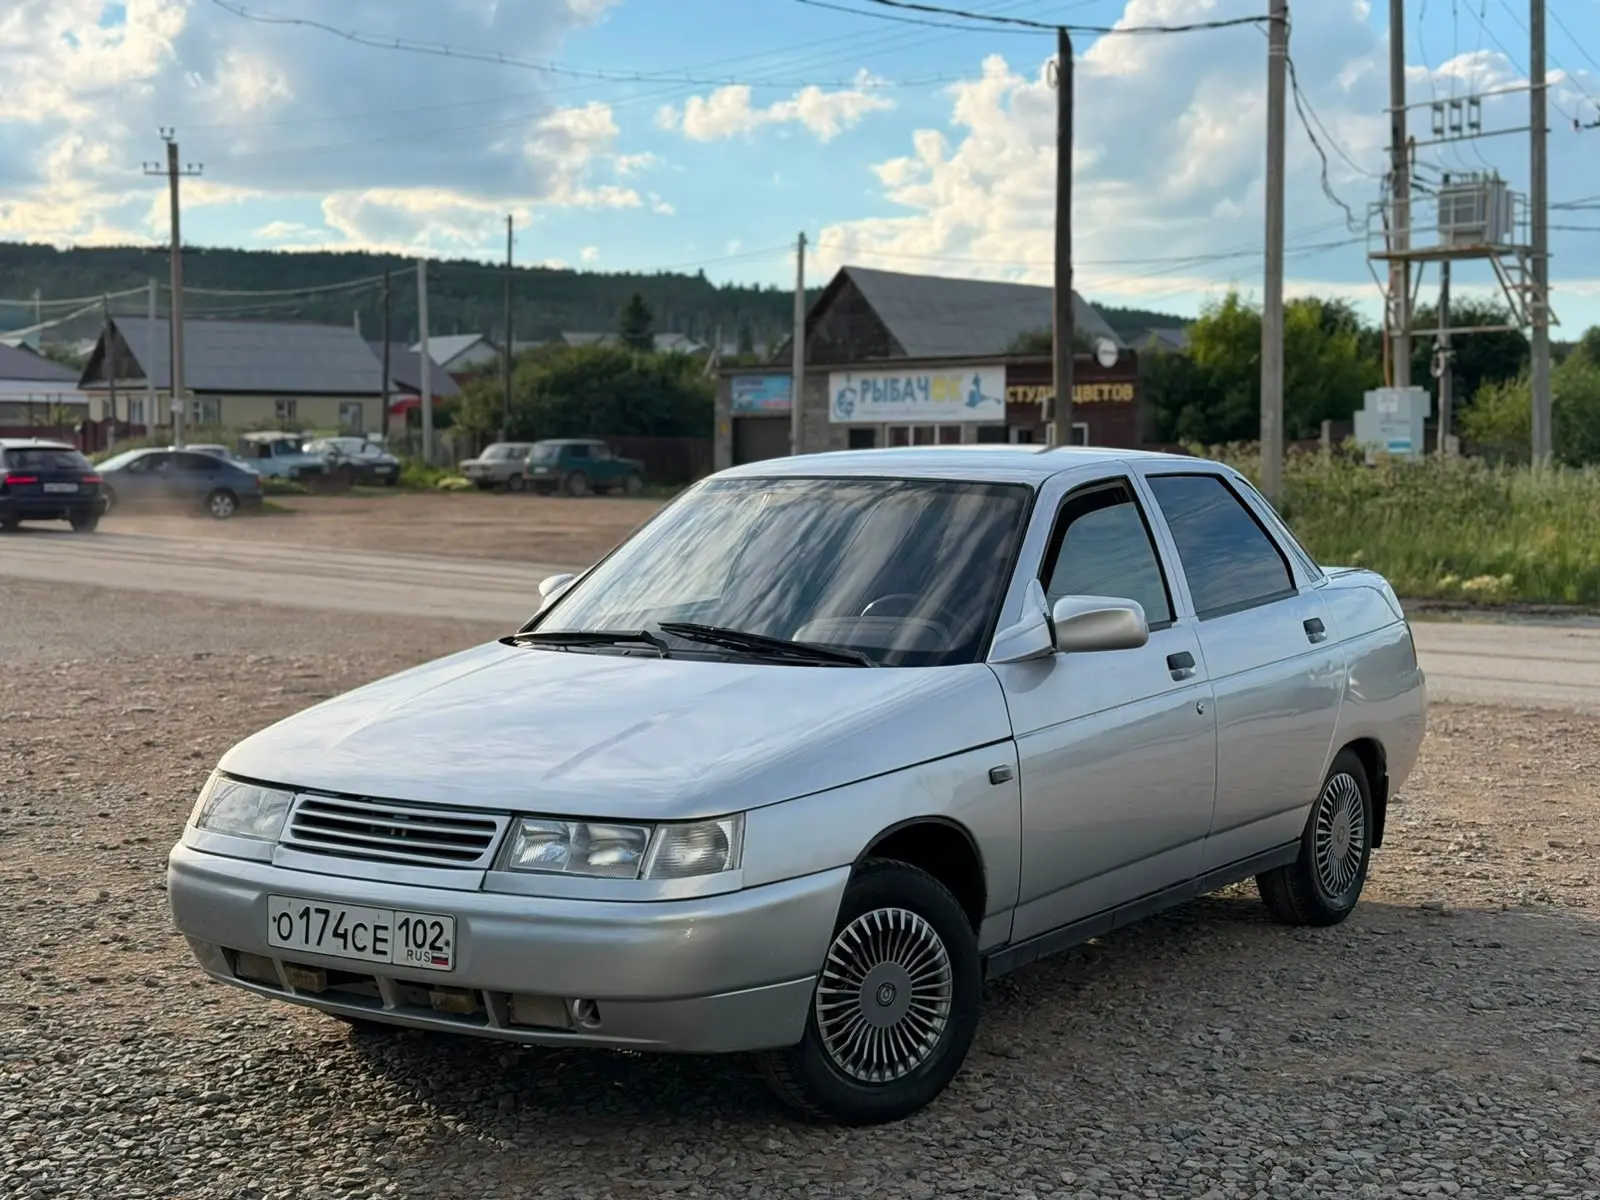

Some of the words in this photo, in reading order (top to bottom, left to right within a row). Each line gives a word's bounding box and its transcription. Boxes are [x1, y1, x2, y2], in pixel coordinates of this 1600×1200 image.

[860, 375, 963, 403] РЫБАЧОК
[1006, 385, 1056, 404] СТУДИ
[1072, 383, 1133, 404] ЦВЕТОВ
[398, 917, 443, 951] 102
[406, 950, 430, 963] RUS
